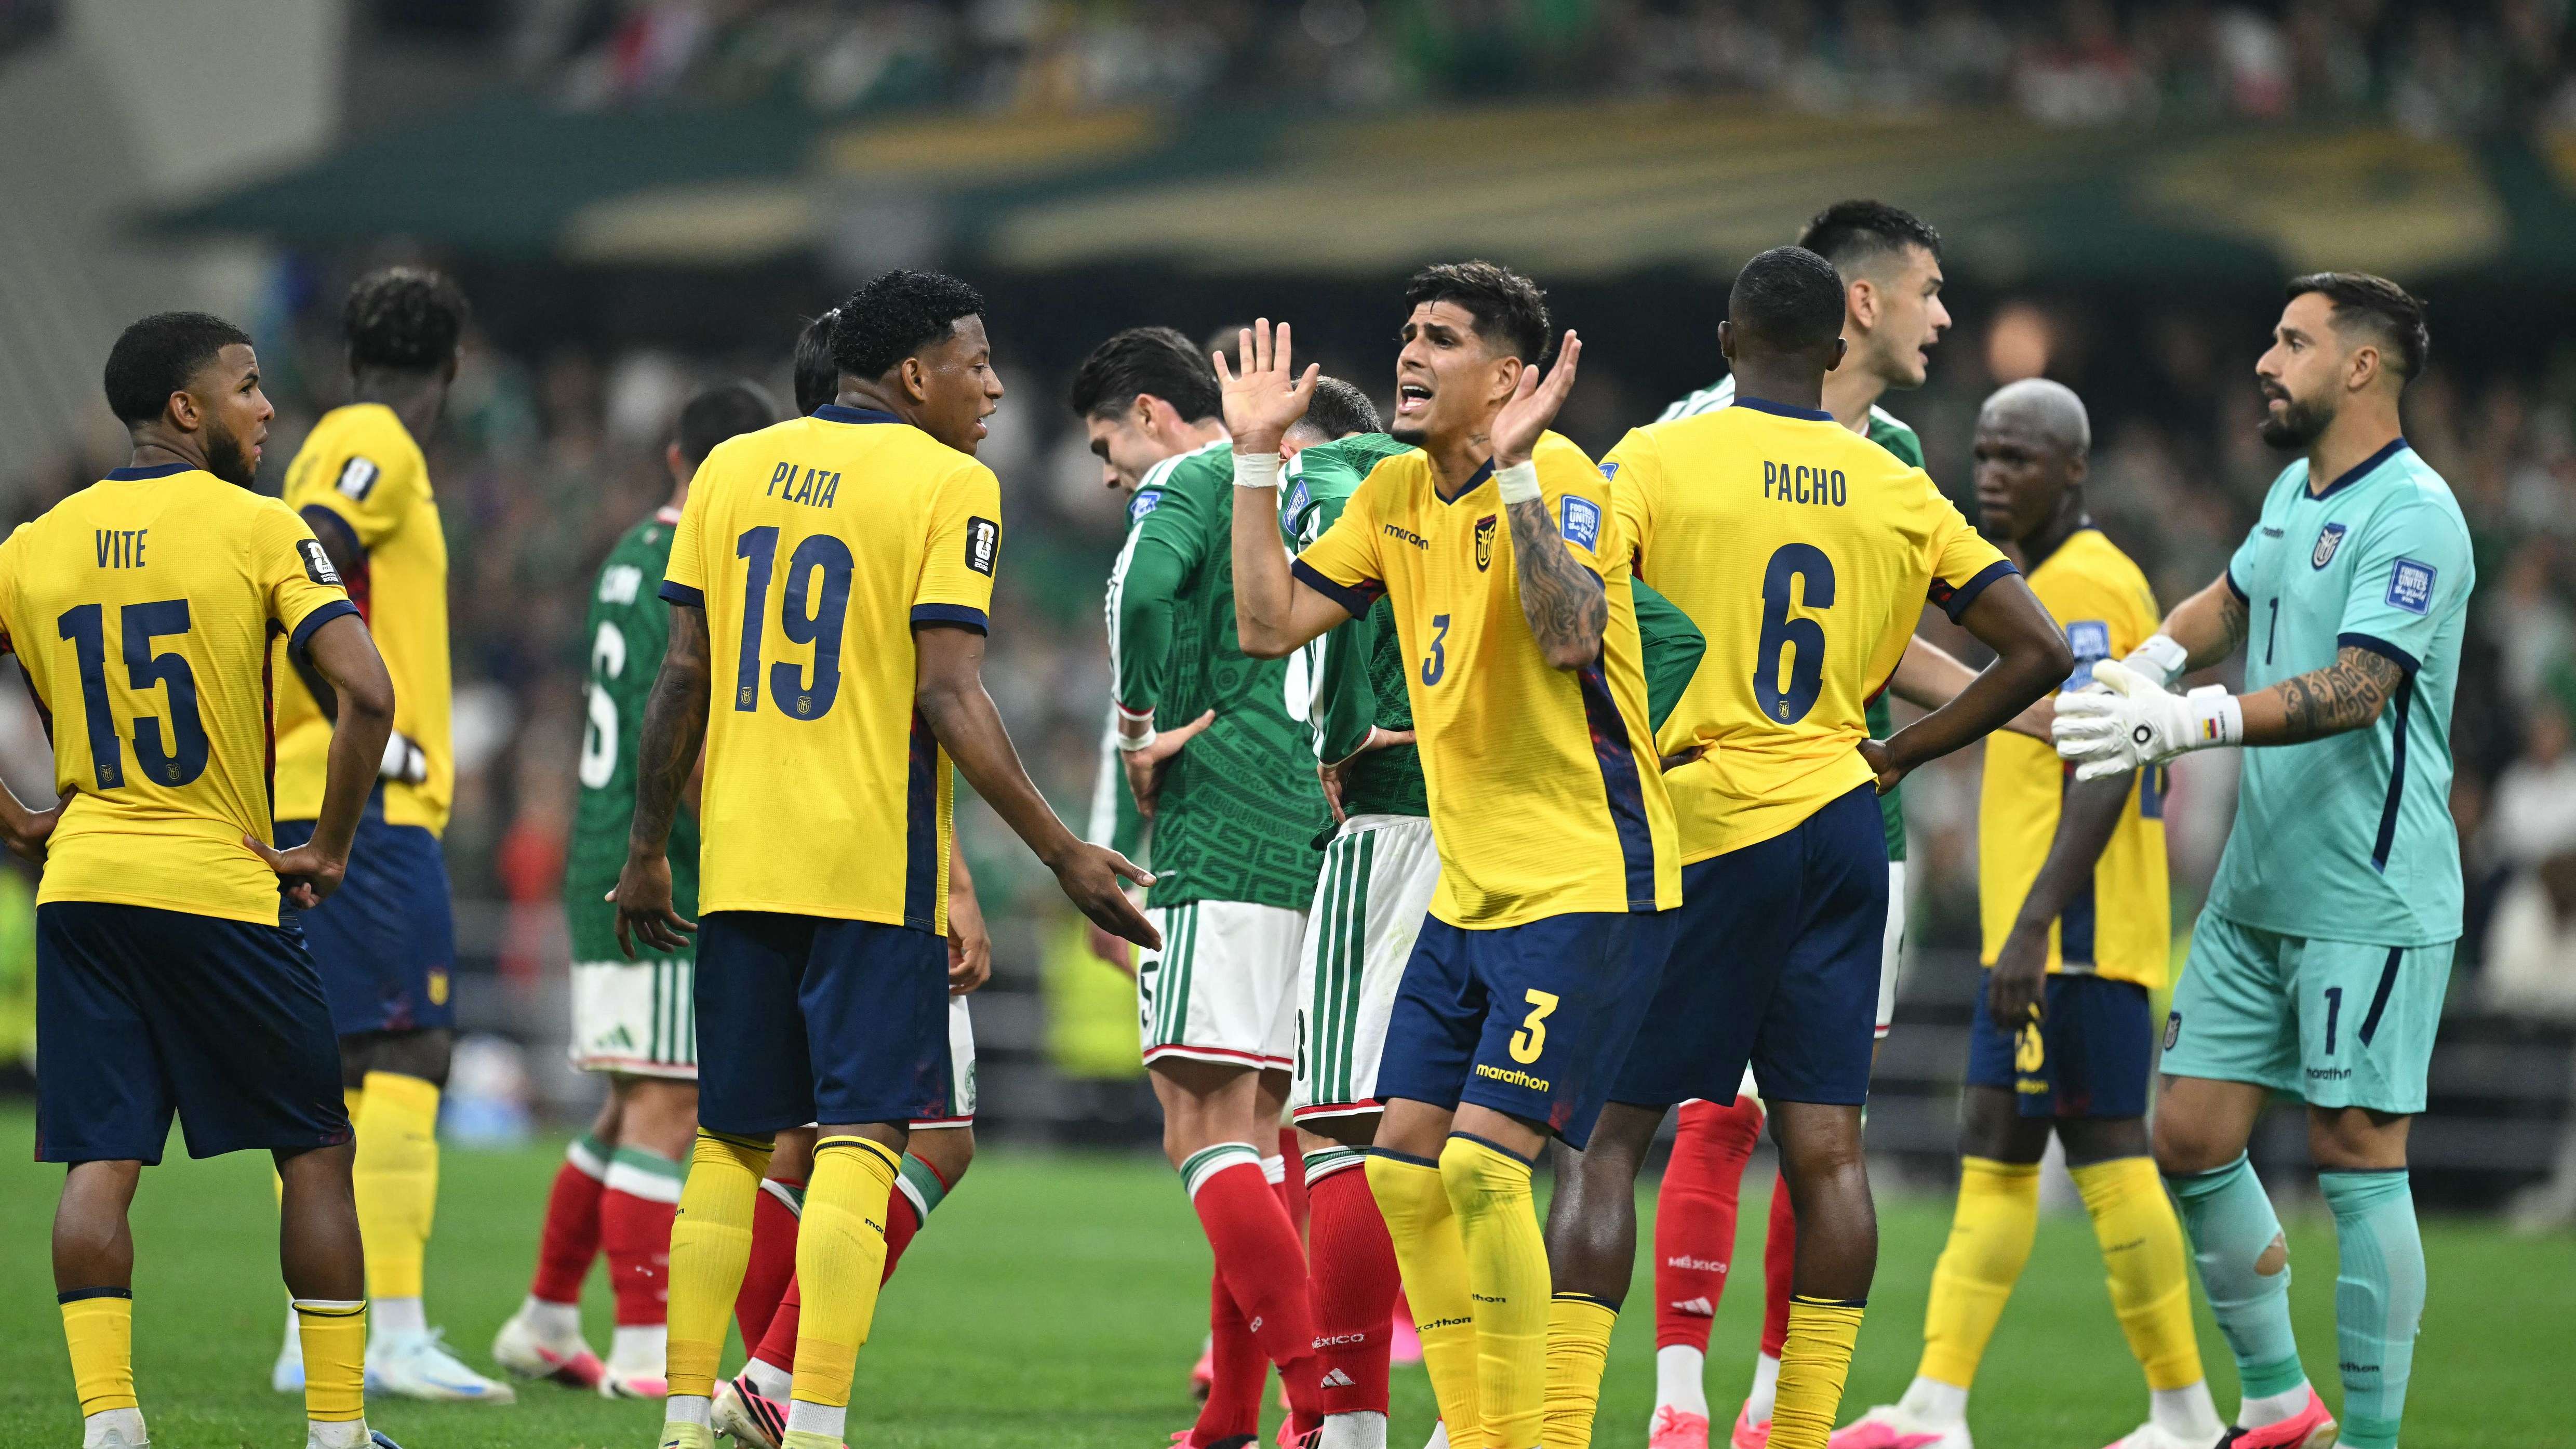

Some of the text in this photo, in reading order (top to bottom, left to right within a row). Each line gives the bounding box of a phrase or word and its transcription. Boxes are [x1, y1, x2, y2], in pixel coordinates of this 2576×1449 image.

[767, 462, 841, 508] PLATA
[1764, 460, 1846, 507] PACHO
[96, 529, 148, 568] VITE
[1570, 511, 1595, 530] UNITES
[736, 526, 855, 721] 19
[1422, 614, 1450, 686] 3
[1753, 542, 1835, 725] 6
[2266, 597, 2278, 665] 1
[57, 599, 209, 790] 15
[1509, 988, 1559, 1064] 3
[2325, 988, 2343, 1055] 1
[1476, 1064, 1550, 1093] marathon
[1668, 1255, 1727, 1274] MÉXICO
[1312, 1333, 1365, 1350] MÉXICO
